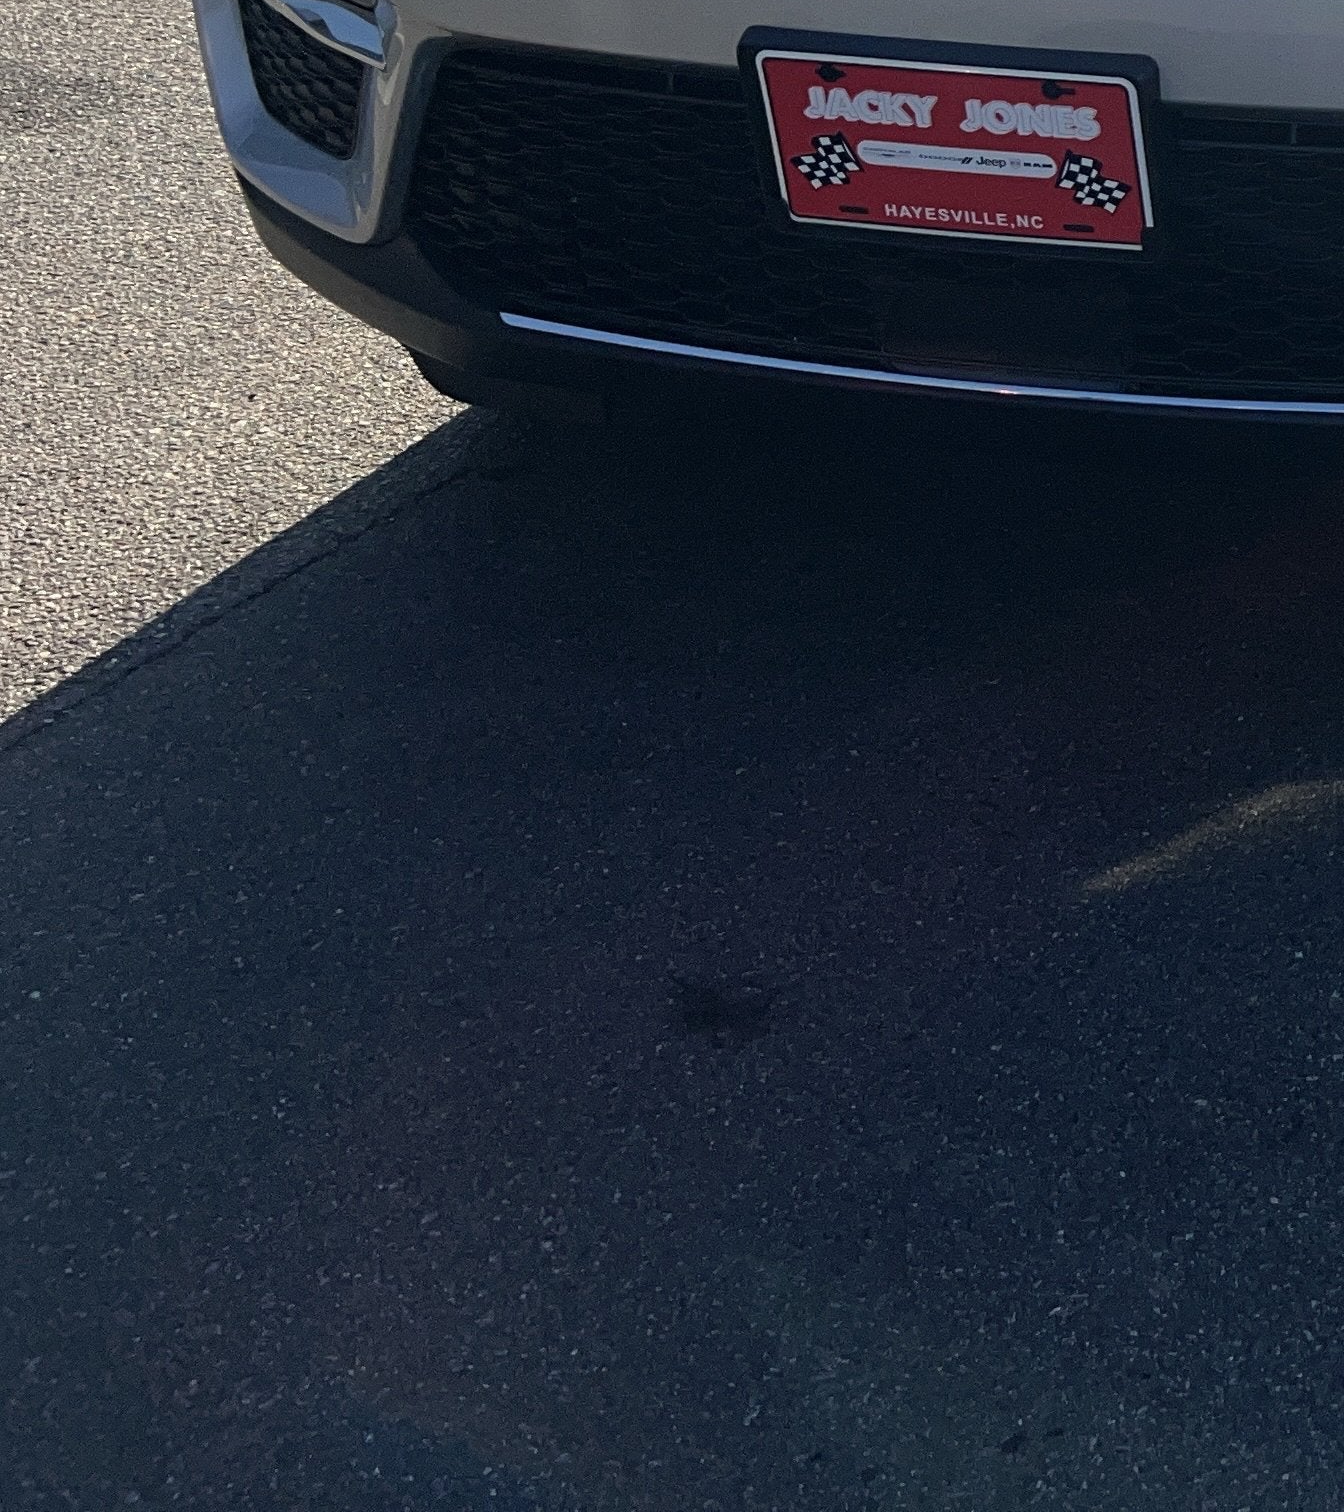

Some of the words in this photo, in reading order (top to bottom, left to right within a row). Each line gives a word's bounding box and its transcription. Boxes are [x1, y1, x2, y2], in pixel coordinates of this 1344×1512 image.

[803, 85, 938, 129] JACKY
[959, 98, 1102, 141] JONES
[976, 155, 1007, 169] Jeep
